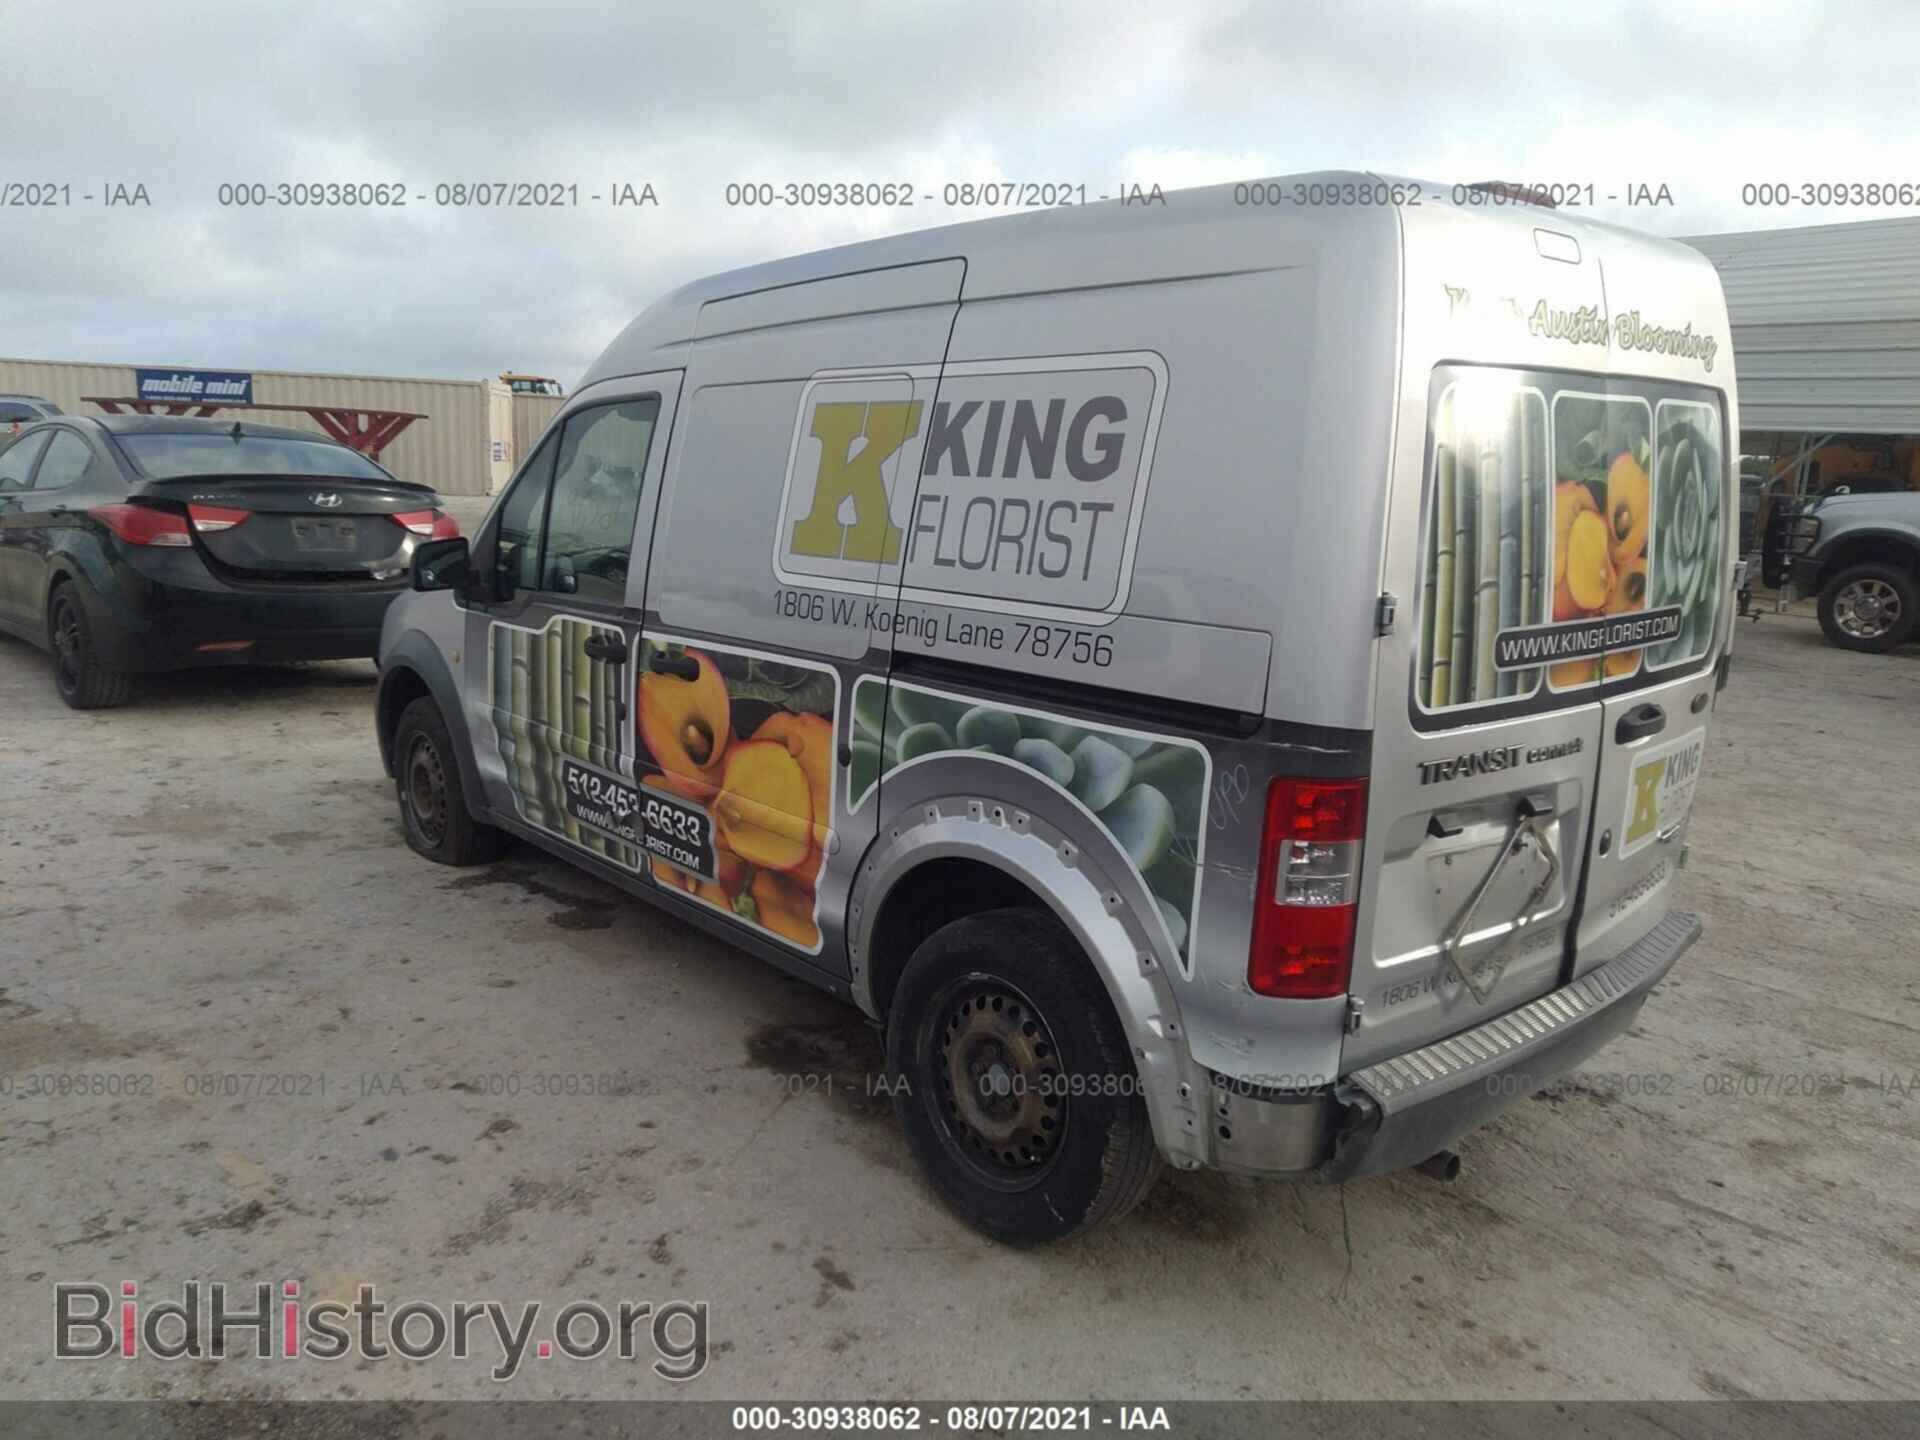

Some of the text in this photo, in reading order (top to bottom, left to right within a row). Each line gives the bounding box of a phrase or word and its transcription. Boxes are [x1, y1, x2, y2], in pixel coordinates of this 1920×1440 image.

[1528, 298, 1610, 346] Austin
[1615, 309, 1718, 373] Blooming
[142, 374, 250, 395] mobile mini
[923, 395, 1129, 483] KING
[789, 399, 925, 566] K
[909, 494, 1115, 581] FLORIST
[774, 589, 1115, 668] 1806 W. Koenig Lane 78756
[1502, 614, 1680, 661] WWW.KINGFLORIST.COM
[1664, 742, 1701, 788] KING
